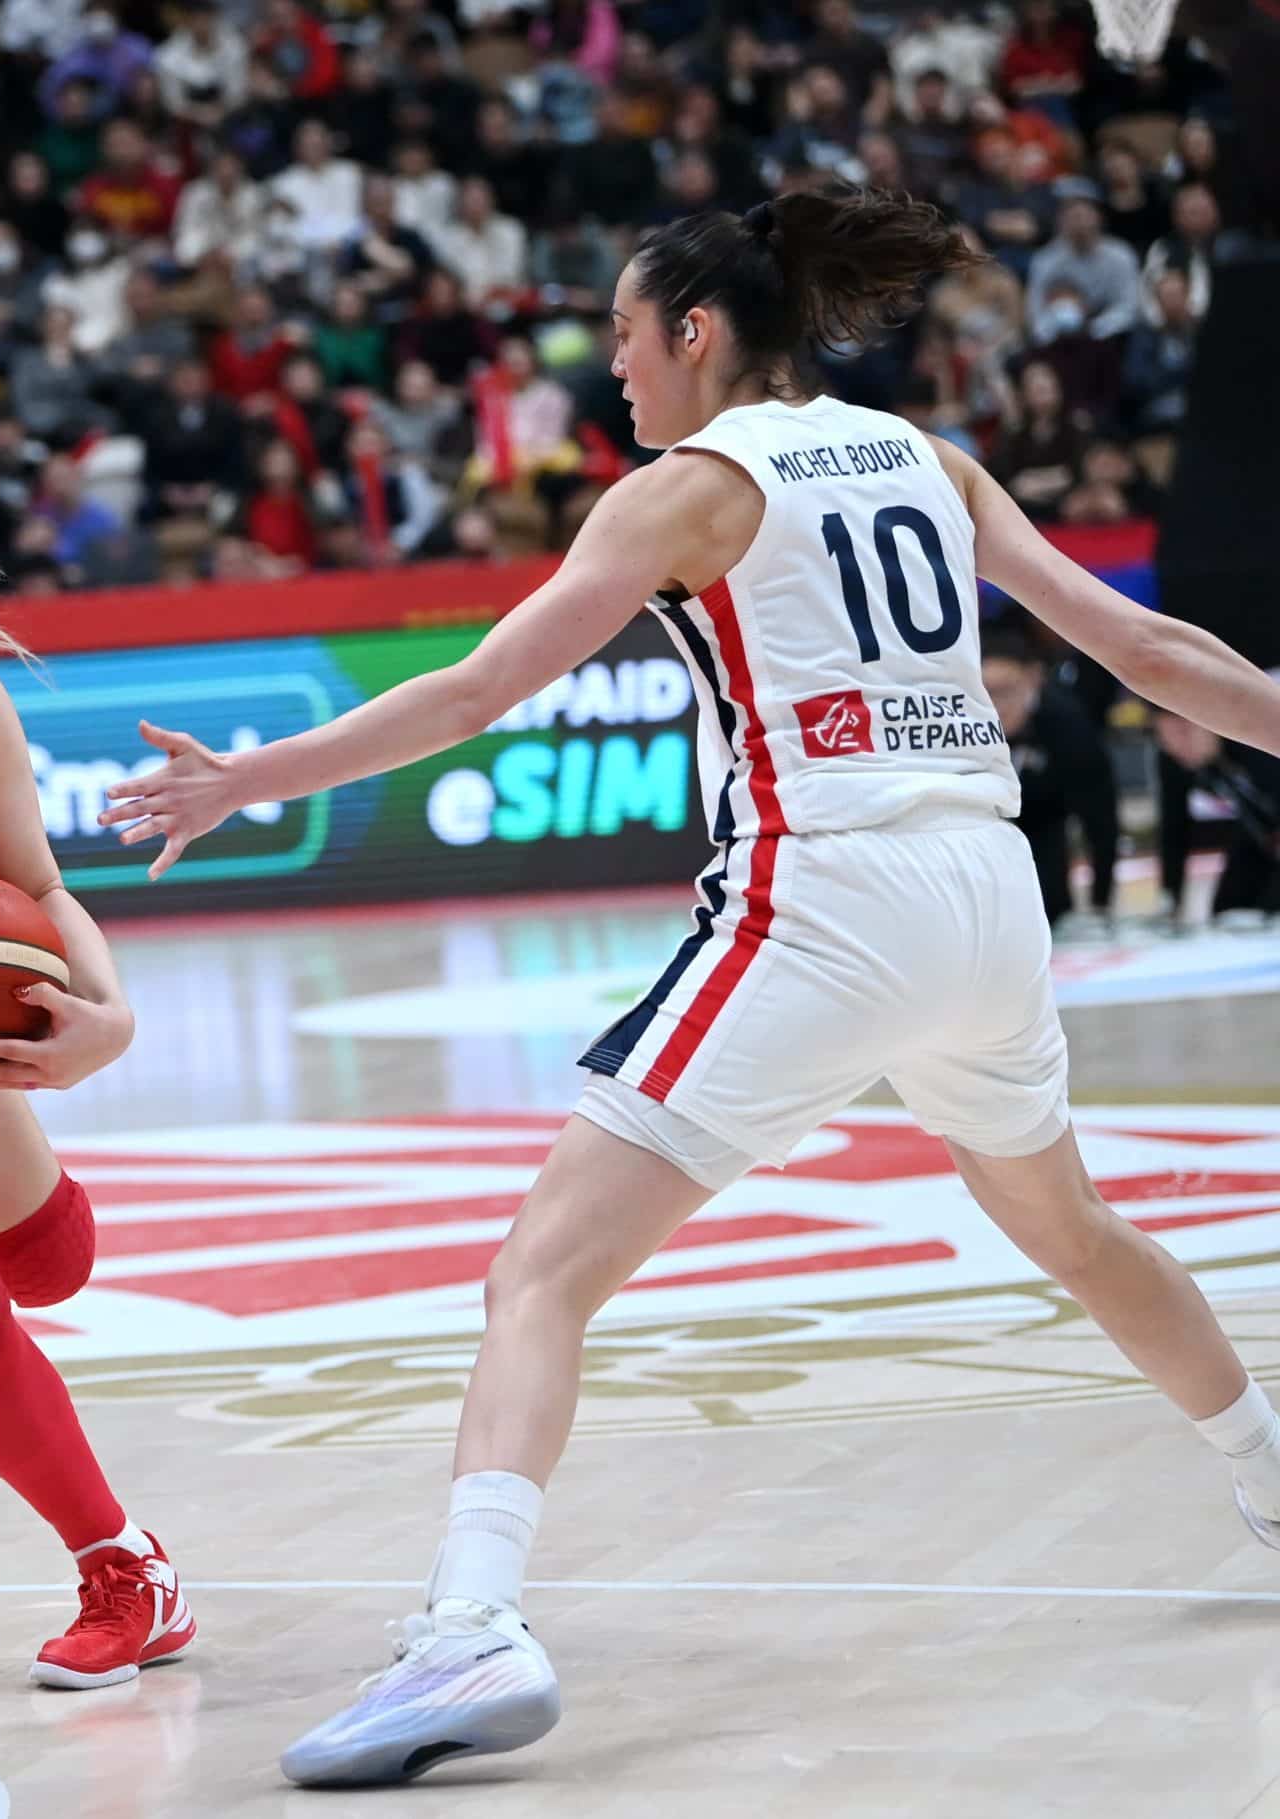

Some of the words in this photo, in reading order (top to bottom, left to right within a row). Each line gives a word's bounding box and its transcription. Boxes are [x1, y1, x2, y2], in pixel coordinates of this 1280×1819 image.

[768, 446, 850, 483] MICHEL
[845, 438, 920, 475] BOURY
[821, 505, 962, 663] 10
[881, 694, 966, 722] CAISSE
[884, 719, 1006, 752] D'EPARGN
[426, 732, 690, 846] eSIM
